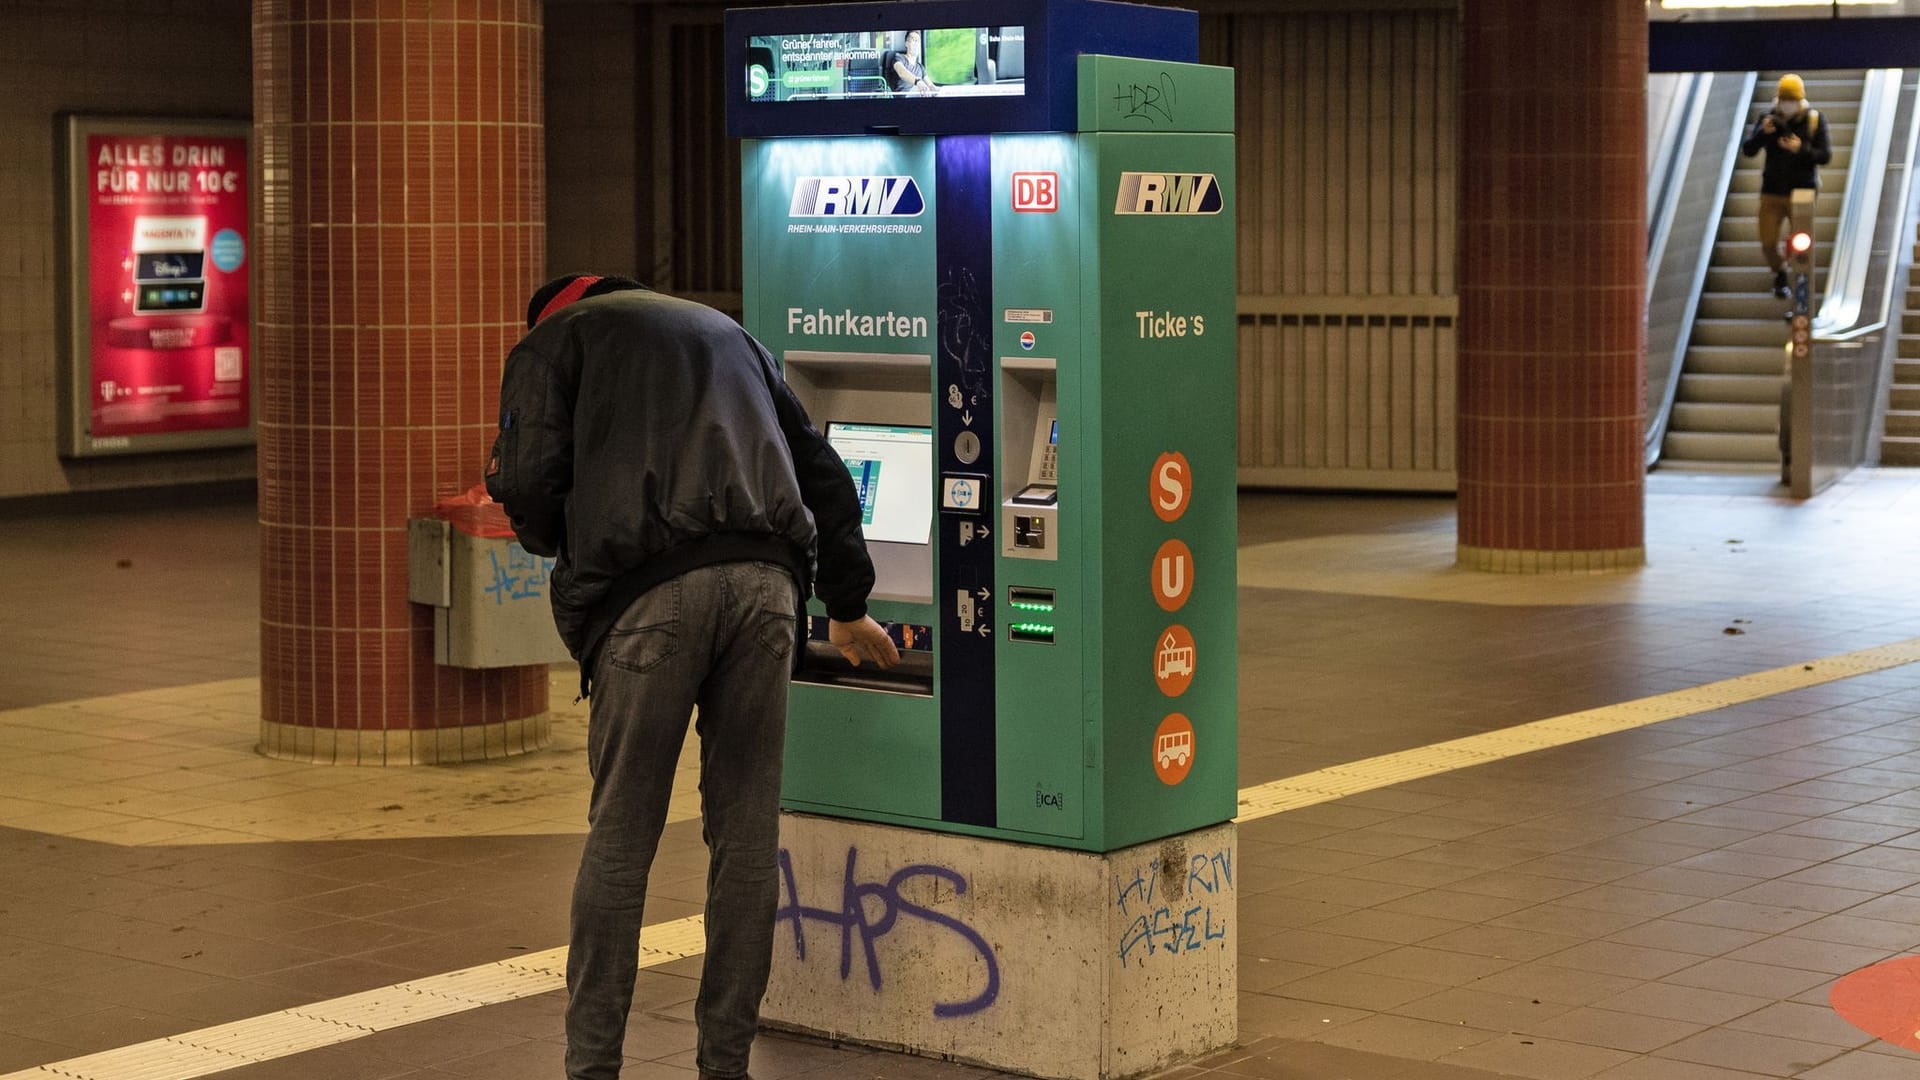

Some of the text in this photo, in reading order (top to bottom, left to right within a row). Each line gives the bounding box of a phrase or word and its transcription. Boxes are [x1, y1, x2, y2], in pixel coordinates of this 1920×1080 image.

[782, 37, 842, 50] Grüner fahren,
[782, 49, 881, 63] entspannter ankommen
[98, 144, 225, 167] ALLES DRIN
[97, 166, 139, 192] FÜR
[146, 170, 191, 192] NUR
[1018, 178, 1052, 206] DB
[812, 177, 910, 215] RMV
[1134, 175, 1213, 213] RMV
[787, 223, 923, 235] RHEIN-MAIN-VERKEHRSVERBUND
[787, 307, 928, 338] Fahrkarten
[1159, 461, 1183, 511] S
[1161, 555, 1185, 598] U
